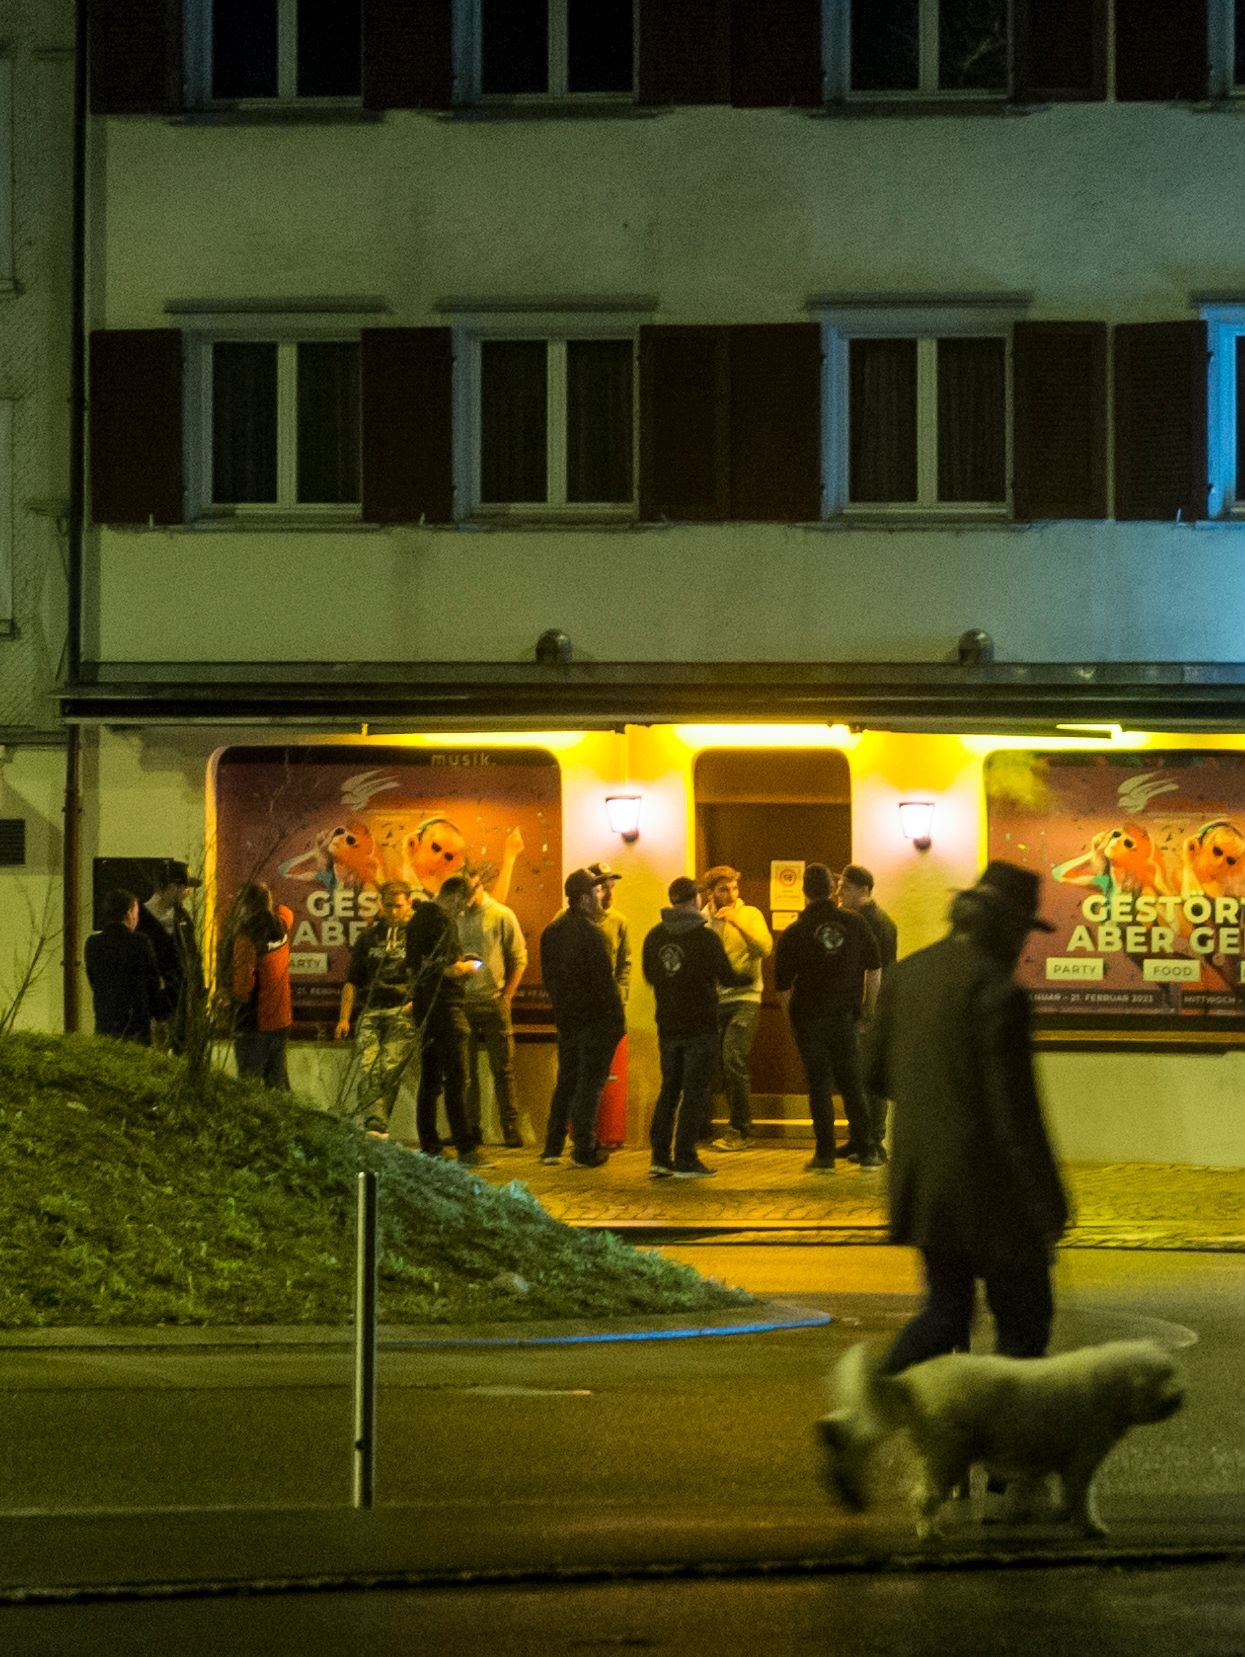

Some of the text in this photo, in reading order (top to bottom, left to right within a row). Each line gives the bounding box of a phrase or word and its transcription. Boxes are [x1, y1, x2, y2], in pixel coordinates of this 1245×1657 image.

[1066, 924, 1176, 953] ABER
[1054, 964, 1097, 975] PARTY
[1153, 966, 1193, 976] FOOD
